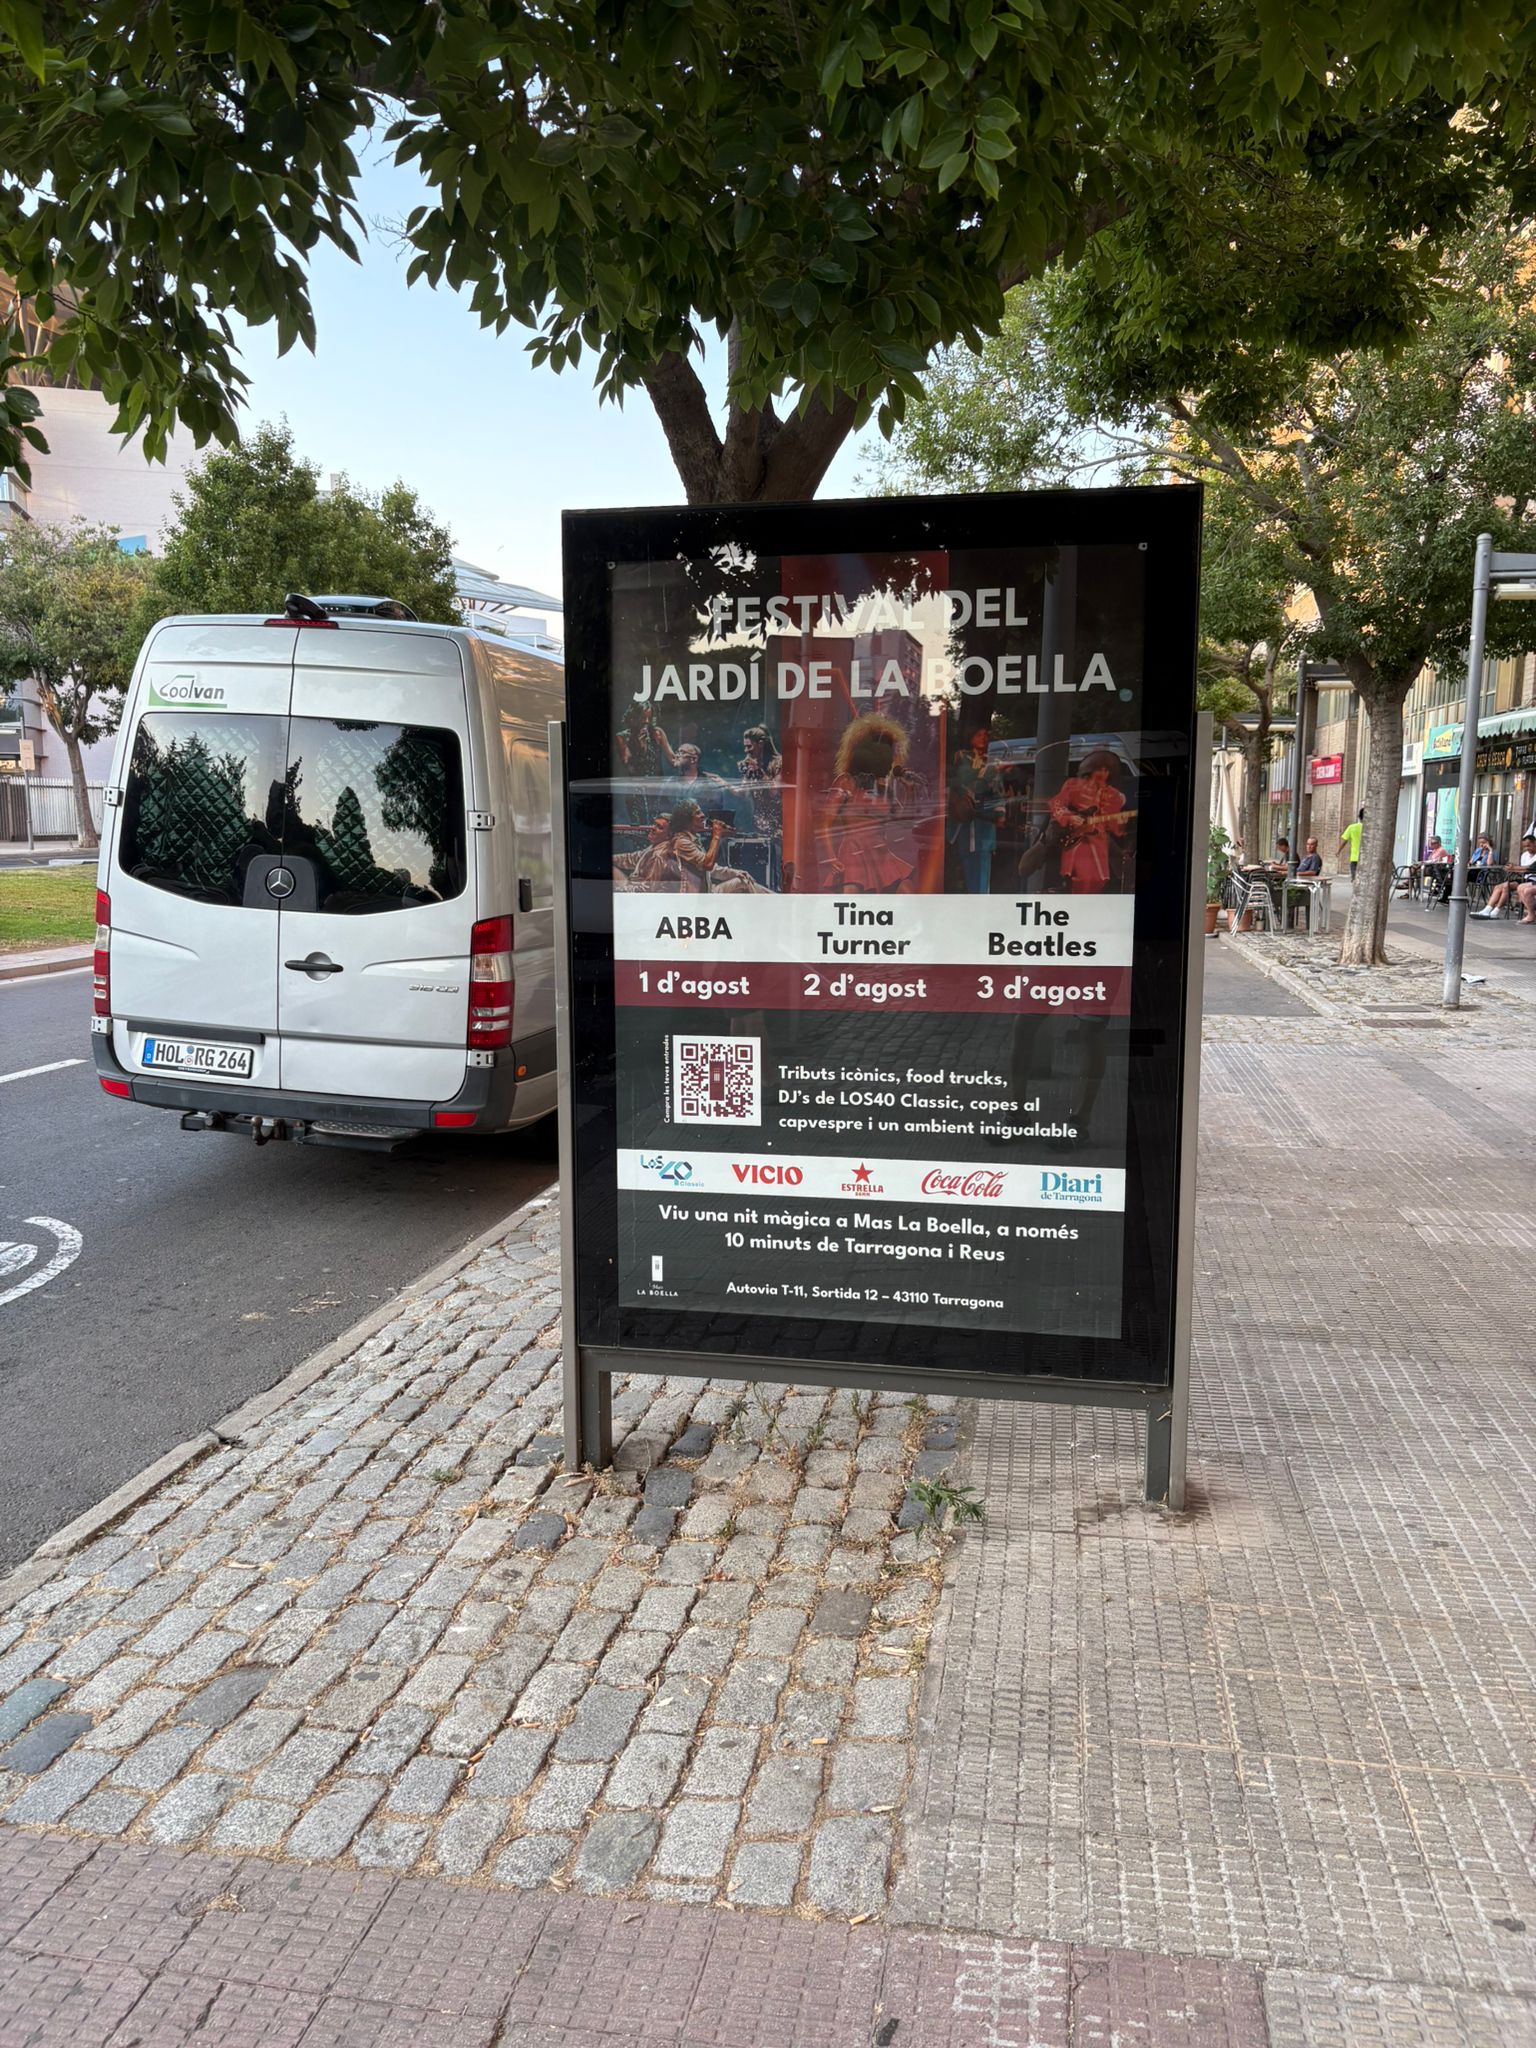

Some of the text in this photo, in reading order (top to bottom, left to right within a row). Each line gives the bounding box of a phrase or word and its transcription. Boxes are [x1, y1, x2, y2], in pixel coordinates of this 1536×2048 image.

[713, 587, 1028, 636] FESTIVAL DEL
[159, 675, 225, 700] Coolvan
[633, 651, 760, 702] JARDÍ
[777, 661, 833, 699] DE
[850, 659, 910, 698] LA
[833, 902, 894, 926] Tina
[1015, 901, 1070, 927] The
[655, 916, 733, 940] ABBA
[817, 931, 911, 956] Turner
[988, 931, 1097, 957] Beatles
[639, 970, 750, 1000] 1 d'agost
[803, 973, 927, 1002] 2 d'agost
[976, 975, 1107, 1007] 3 d'agost
[155, 1043, 247, 1071] HOL RG 264
[778, 1065, 1008, 1088] Tributs icònics, food trucks,
[663, 1096, 671, 1123] Compra
[778, 1089, 1040, 1114] DJ's de LOS40 Classic, copes al
[778, 1116, 1078, 1140] capvespre i un ambient inigualable
[731, 1164, 803, 1186] VICIO
[921, 1168, 1009, 1198] Coca-Cola
[1040, 1171, 1103, 1194] Diari
[841, 1183, 884, 1194] ESTRELLA
[1040, 1192, 1103, 1203] de Tarragona
[658, 1204, 1079, 1240] Viu una nit màgica a Mas La Boella, a només
[724, 1232, 1005, 1262] 10 minuts de Tarragona i Reus
[649, 1289, 679, 1297] BOELLA
[726, 1281, 778, 1295] Autovia
[781, 1284, 808, 1298] T-11,
[811, 1286, 861, 1300] Sortida
[864, 1289, 878, 1301] 12
[892, 1290, 929, 1304] 43110
[932, 1292, 1004, 1310] Tarragona
